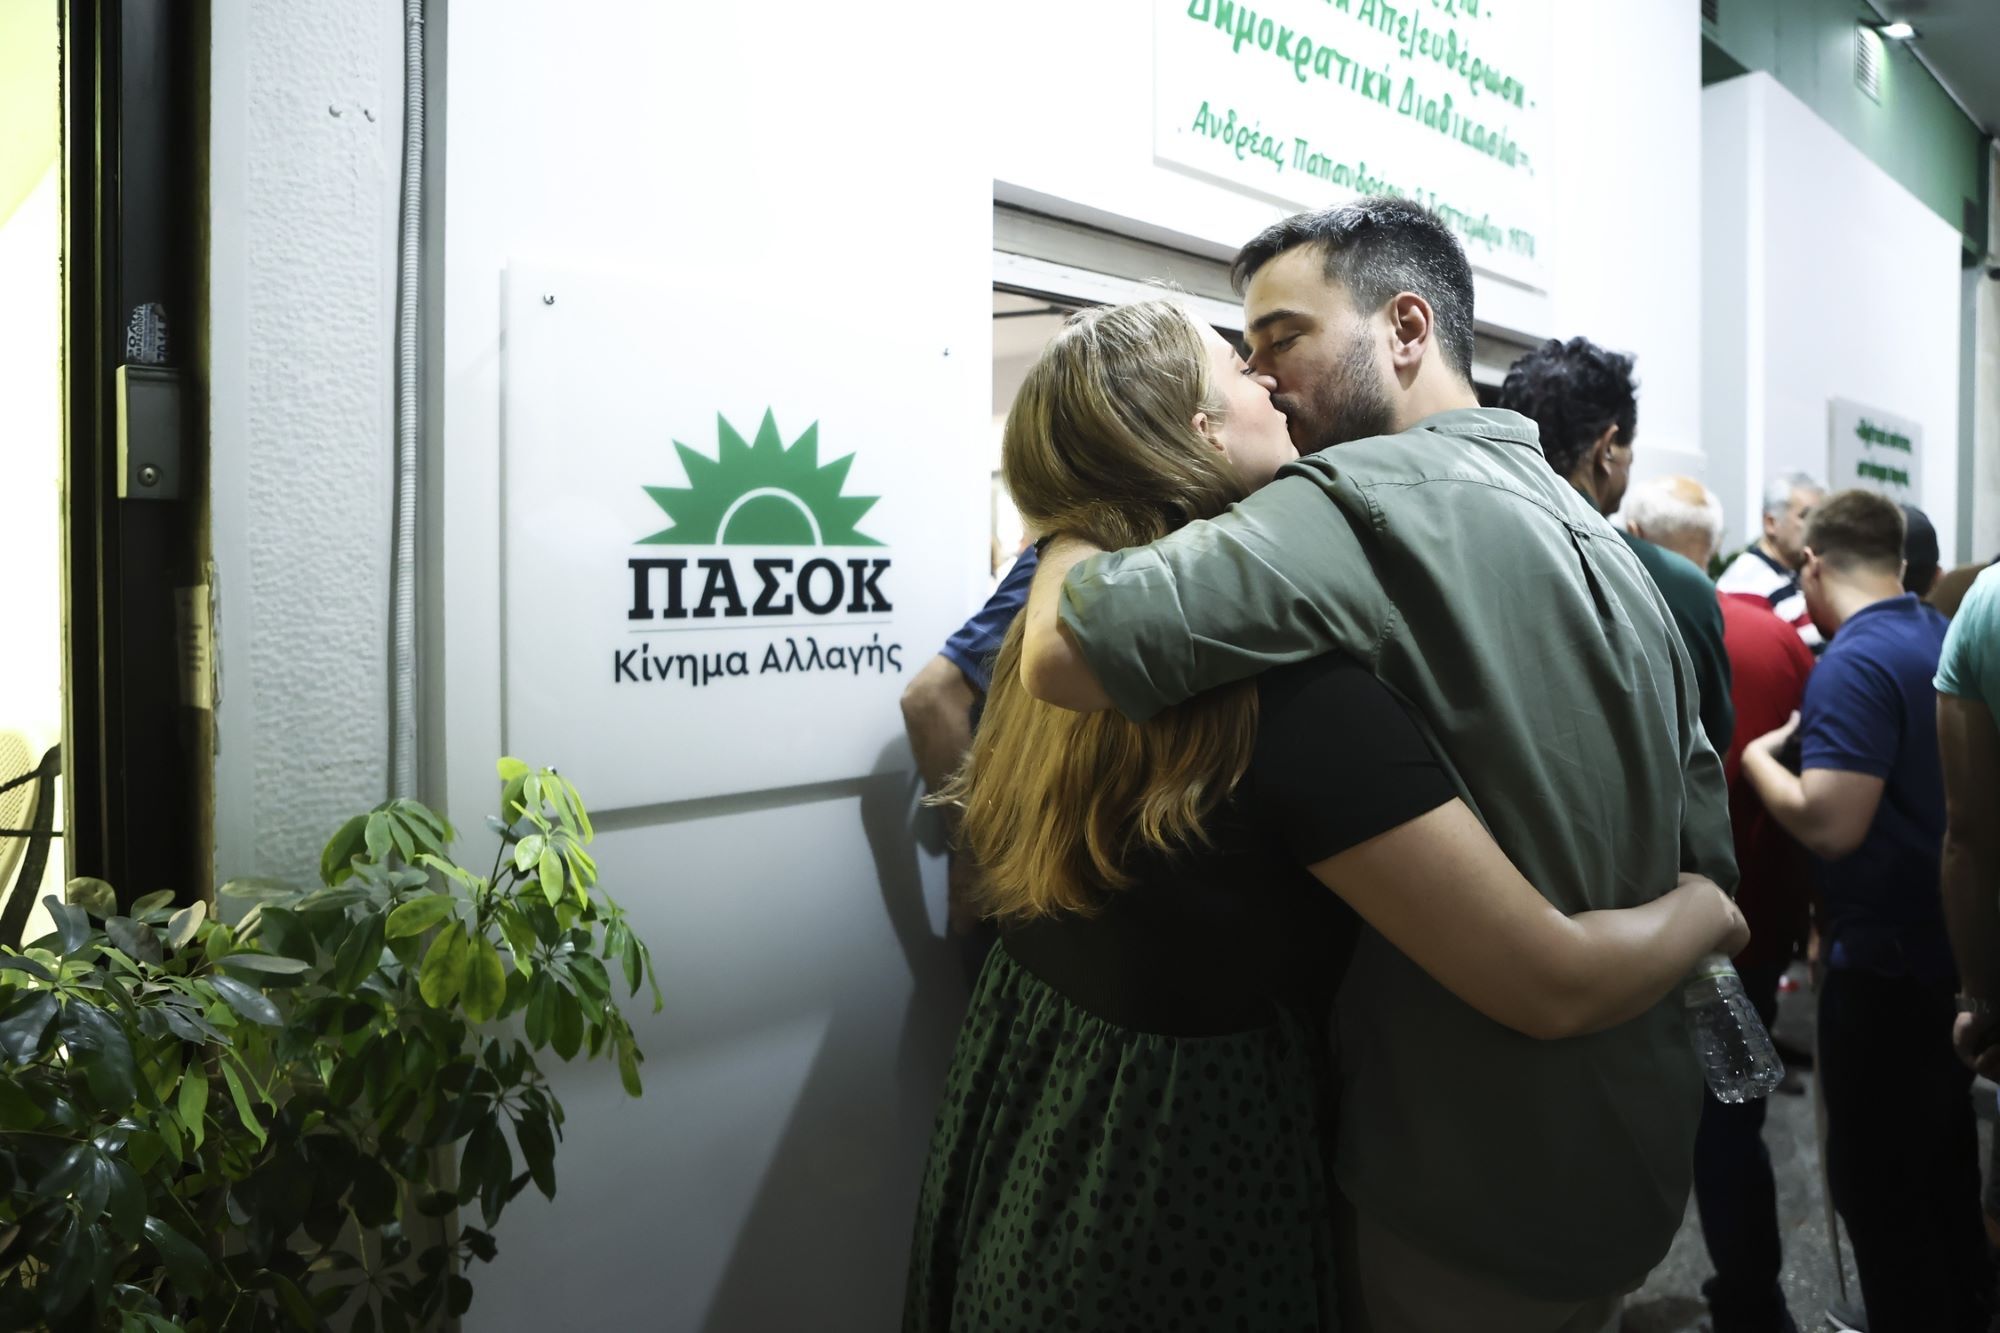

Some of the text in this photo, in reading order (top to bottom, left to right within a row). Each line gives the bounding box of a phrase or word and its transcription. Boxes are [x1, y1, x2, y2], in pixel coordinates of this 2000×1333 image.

[1192, 100, 1284, 173] Ανδρέας
[628, 557, 893, 620] ΠΑΣΟΚ
[614, 632, 903, 687] Κίνημα Αλλαγής
